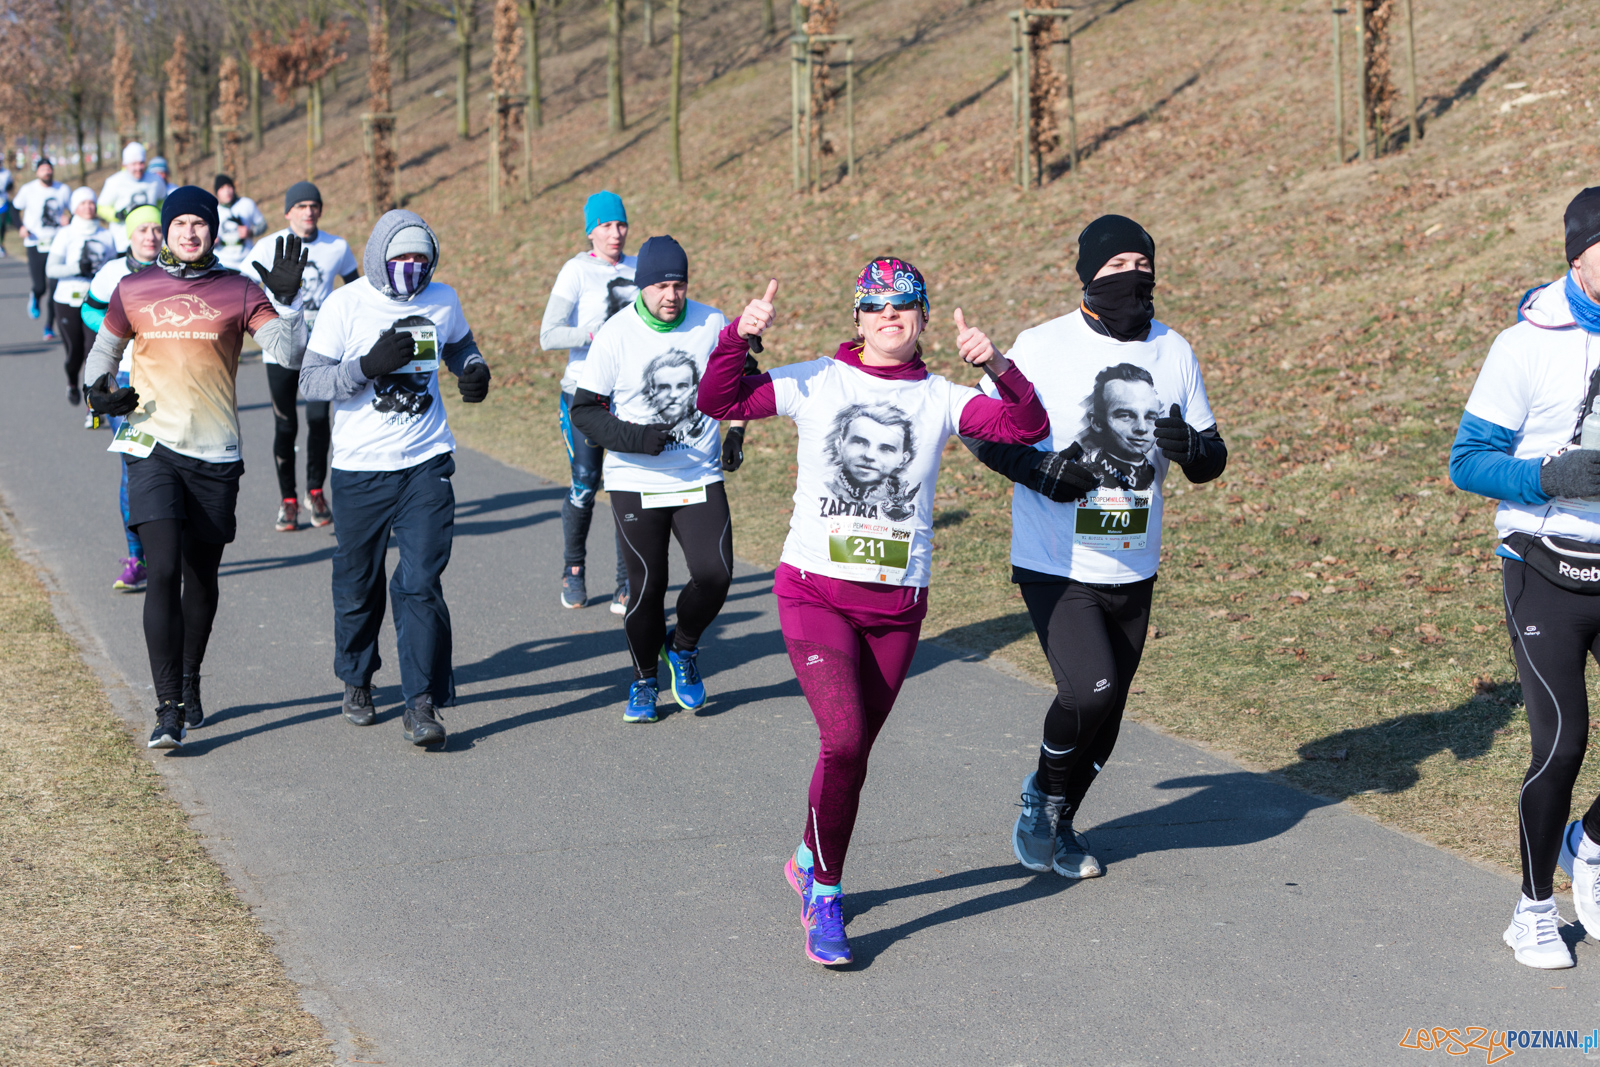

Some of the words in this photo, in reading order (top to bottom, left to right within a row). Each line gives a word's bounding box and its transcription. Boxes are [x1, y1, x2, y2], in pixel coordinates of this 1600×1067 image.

[142, 331, 191, 340] BIEGAJĄCE
[192, 331, 219, 340] DZIKI
[819, 496, 878, 520] ZAPORA
[1099, 511, 1131, 528] 770
[852, 538, 885, 558] 211
[1559, 560, 1600, 582] Reeb
